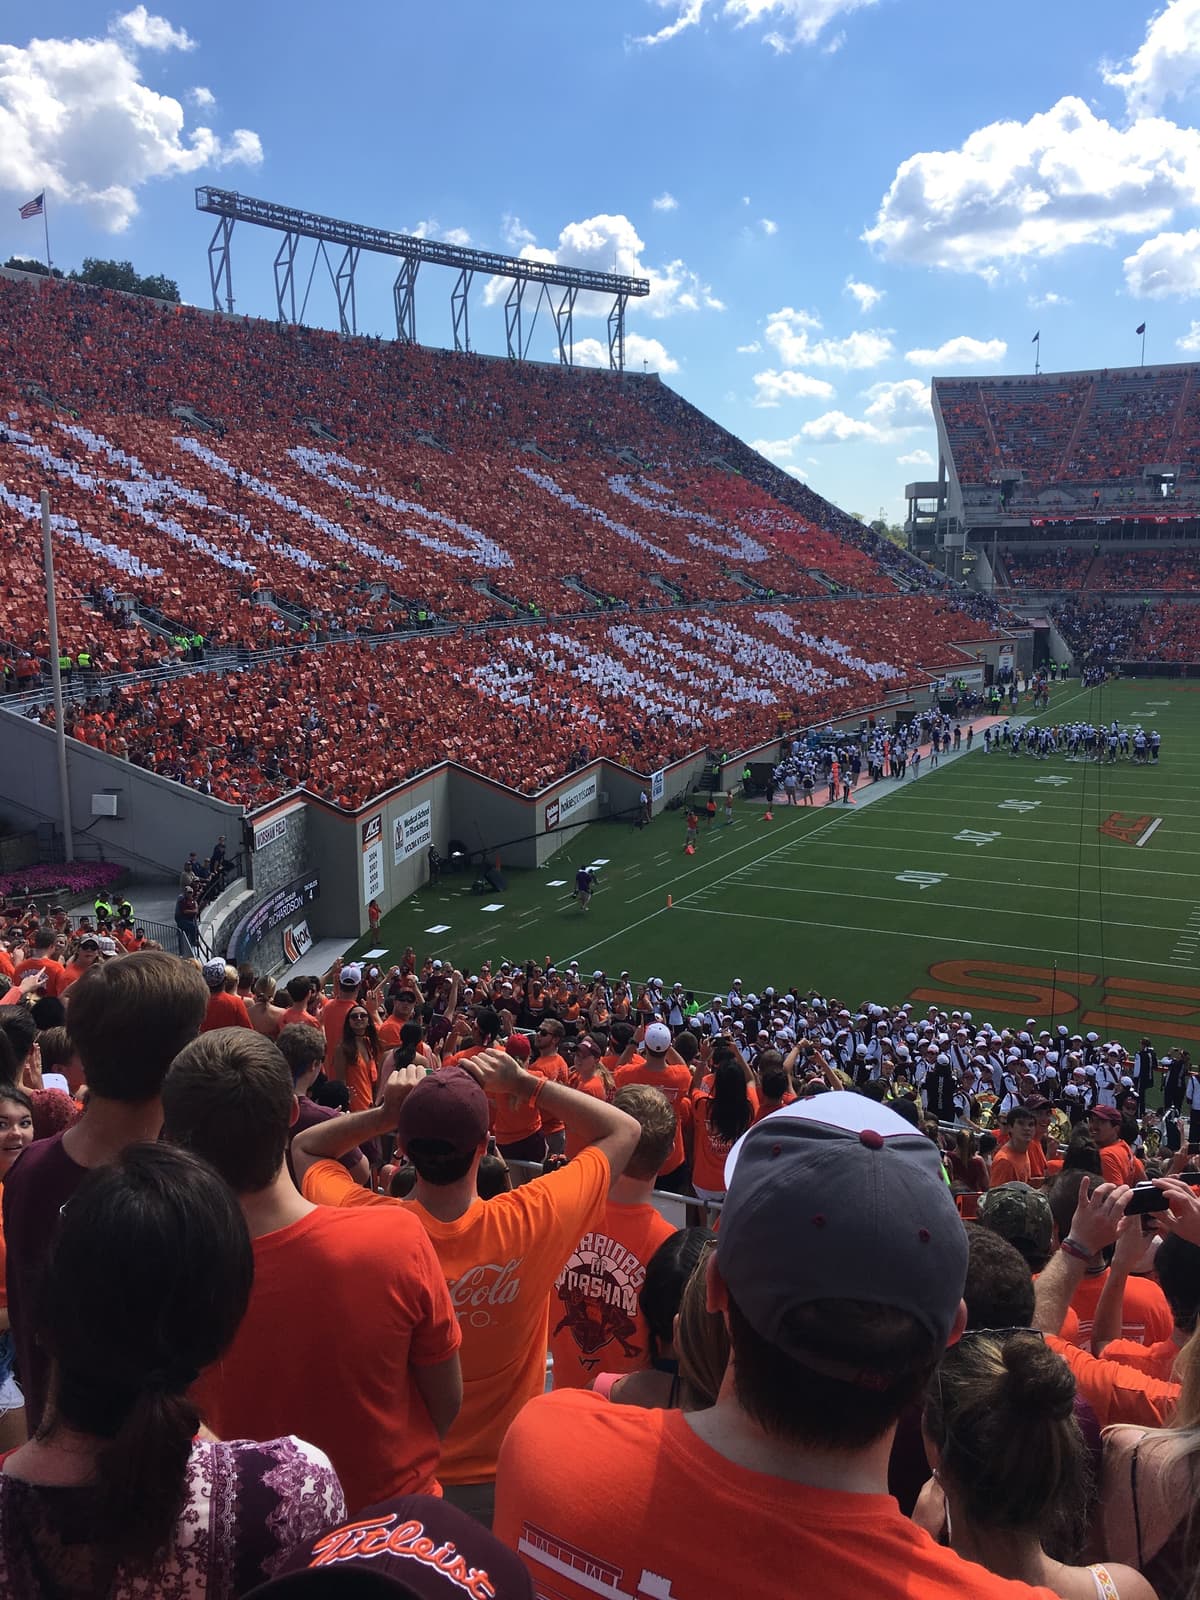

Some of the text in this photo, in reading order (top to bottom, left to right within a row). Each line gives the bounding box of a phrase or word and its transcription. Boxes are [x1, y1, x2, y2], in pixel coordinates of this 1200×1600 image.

[268, 895, 304, 929] RICHARDSON
[575, 1231, 647, 1289] RRIORS
[307, 1513, 496, 1600] Titleist
